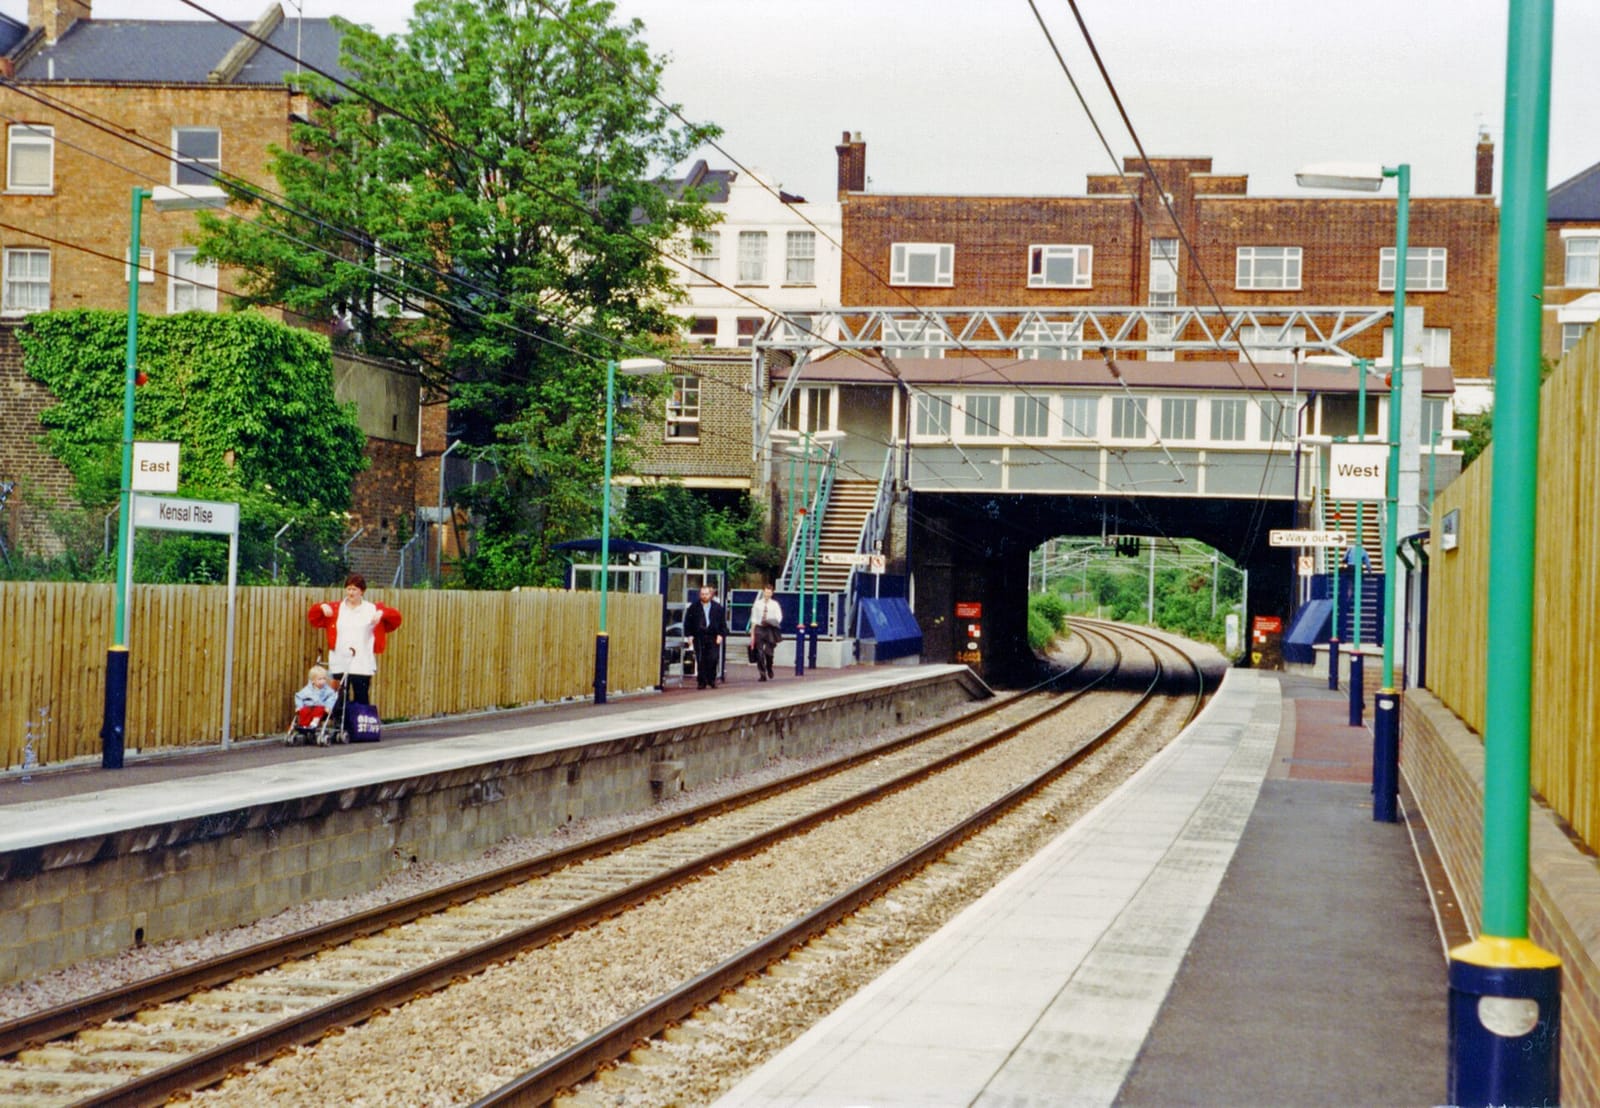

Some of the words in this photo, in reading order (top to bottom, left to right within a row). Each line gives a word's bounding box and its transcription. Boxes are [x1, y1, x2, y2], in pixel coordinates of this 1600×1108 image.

[140, 460, 170, 472] East
[1337, 463, 1379, 477] West
[160, 503, 191, 522] Kensal
[193, 506, 213, 523] Rise
[1285, 533, 1307, 543] Way
[1312, 533, 1329, 542] out
